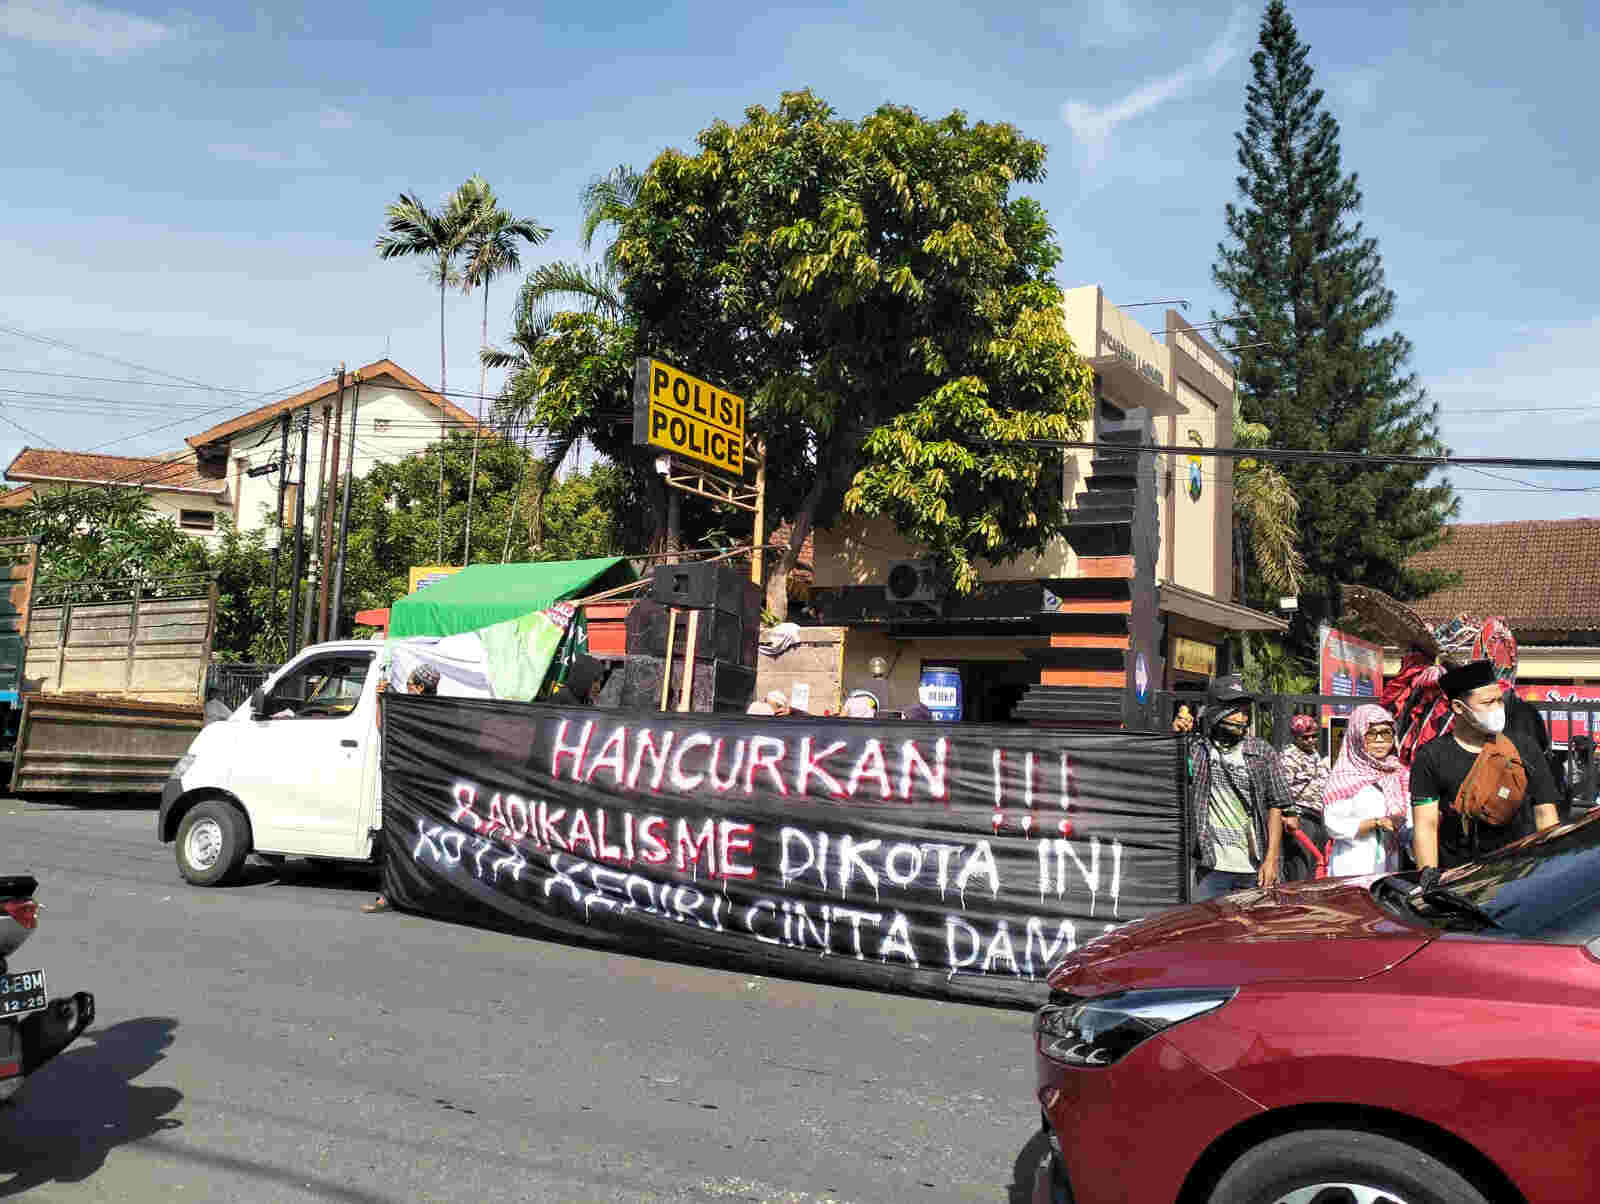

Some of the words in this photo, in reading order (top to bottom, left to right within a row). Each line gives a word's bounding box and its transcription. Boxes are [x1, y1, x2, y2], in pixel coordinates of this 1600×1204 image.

[653, 410, 740, 466] POLICE
[654, 367, 741, 429] POLISI
[551, 719, 950, 800] HANCURKAN
[451, 783, 757, 880] RADIKALISME
[780, 827, 1000, 905] DIKOTA
[1039, 836, 1122, 908] INI
[414, 820, 527, 881] KOTA
[545, 854, 724, 931] KEDIRI
[745, 901, 919, 967] CINTA
